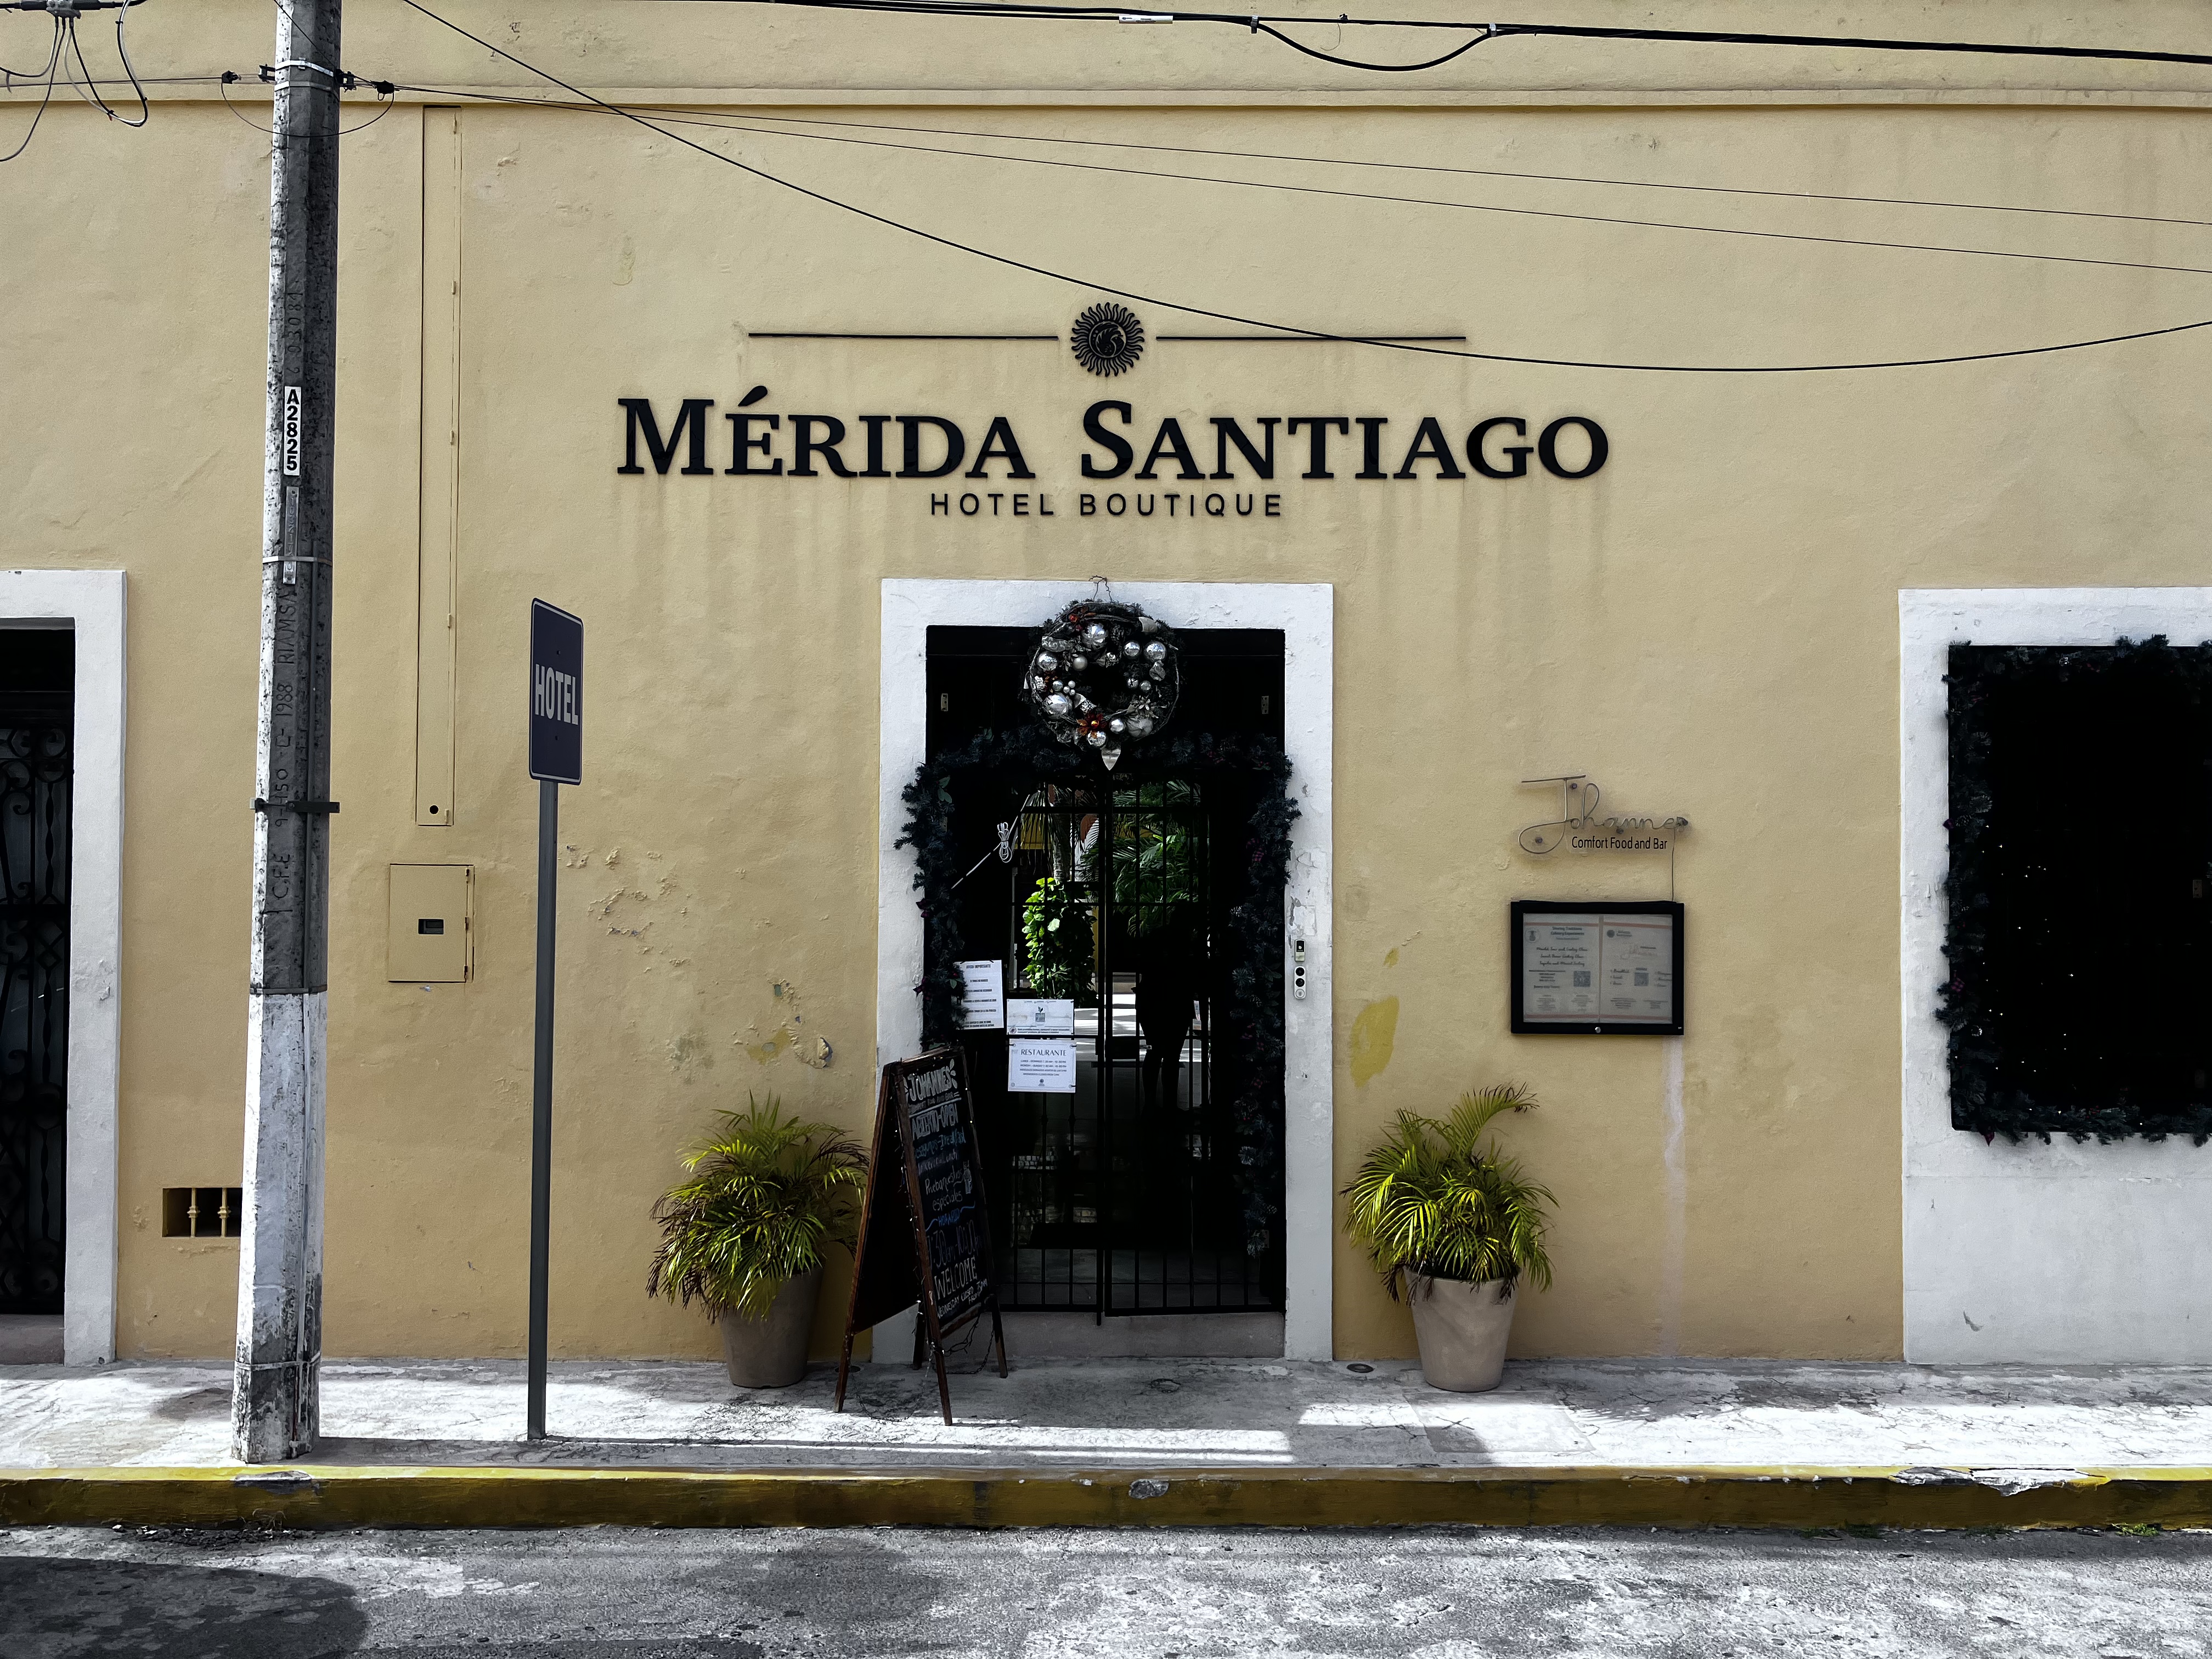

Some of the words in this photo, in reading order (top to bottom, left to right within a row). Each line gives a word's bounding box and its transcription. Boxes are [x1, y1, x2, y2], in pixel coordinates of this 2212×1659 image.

[286, 389, 300, 471] A2825
[617, 385, 1036, 479] MÉRIDA
[1080, 399, 1610, 481] SANTIAGO
[930, 493, 1054, 517] HOTEL
[1078, 493, 1283, 517] BOUTIQUE
[275, 684, 293, 716] 1988
[535, 664, 578, 725] HOTEL
[1572, 836, 1609, 849] Comfort
[1611, 837, 1633, 849] Food
[1635, 837, 1650, 849] and
[1654, 838, 1667, 849] Bar
[907, 1065, 952, 1101] JOHANNES
[934, 1255, 978, 1300] WELCOME
